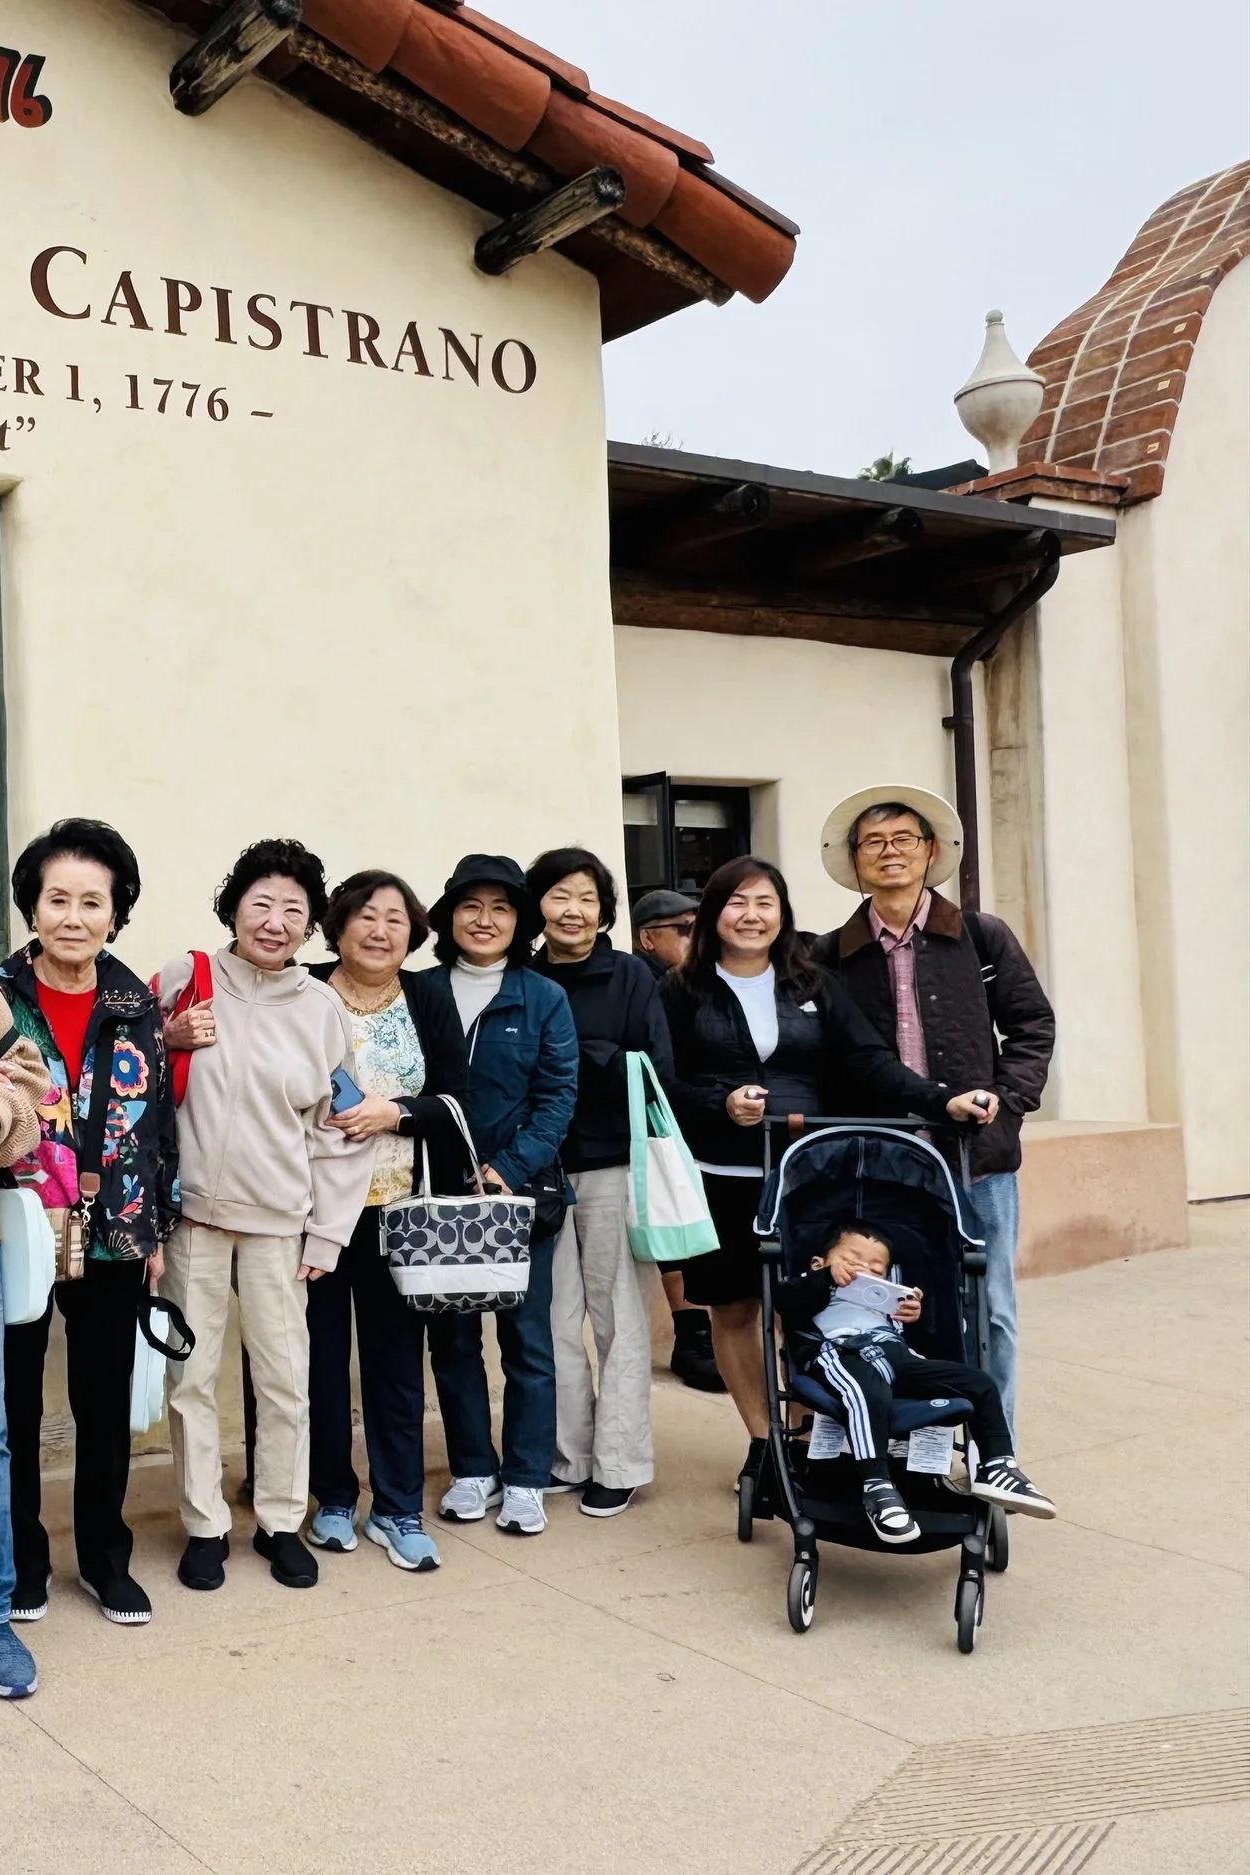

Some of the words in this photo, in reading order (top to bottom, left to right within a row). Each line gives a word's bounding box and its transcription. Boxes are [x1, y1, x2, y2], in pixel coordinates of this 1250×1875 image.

[29, 245, 538, 395] CAPISTRANO
[65, 364, 102, 413] 1,
[124, 374, 229, 422] 1776
